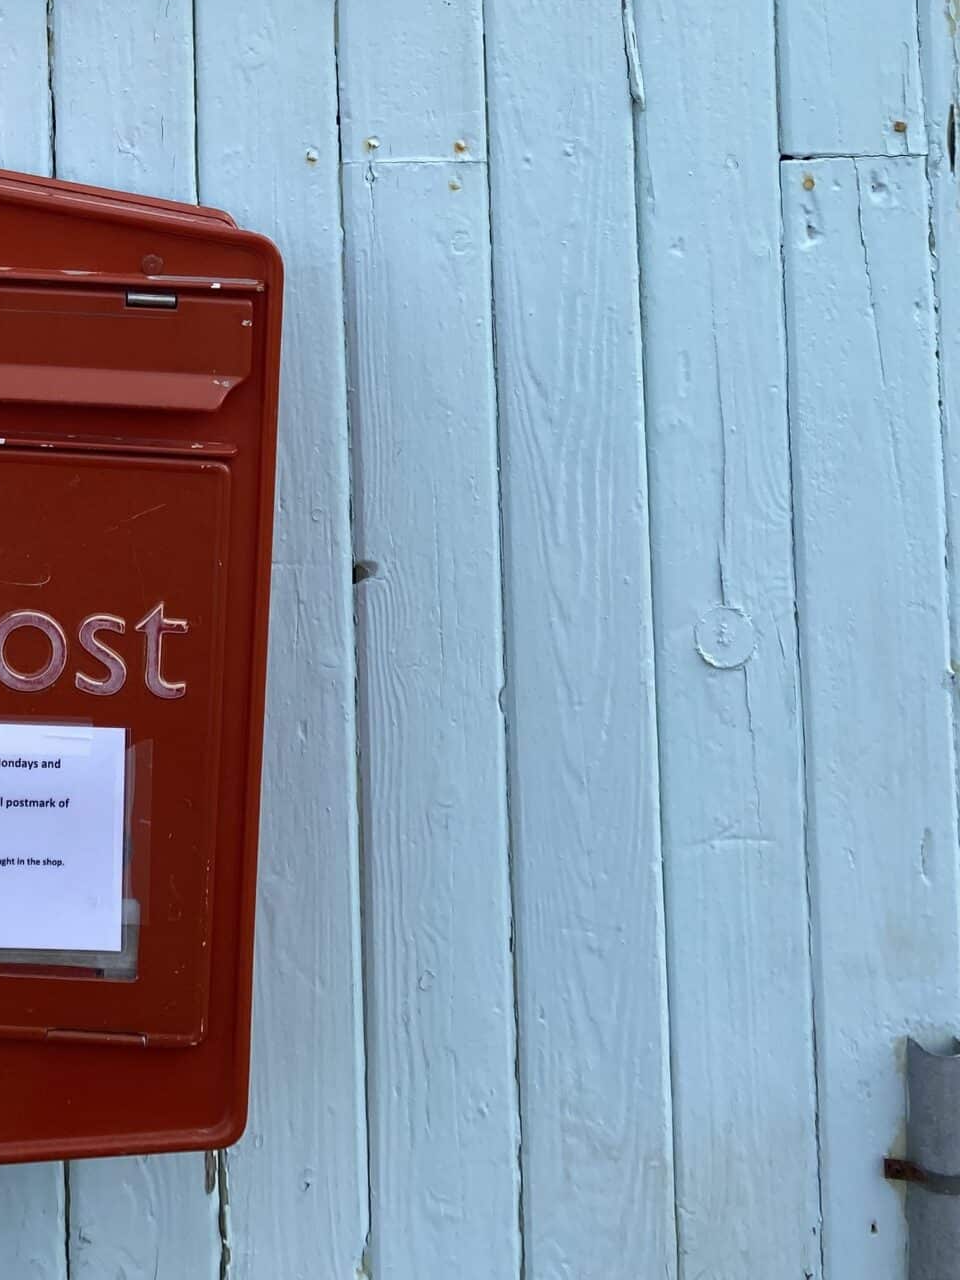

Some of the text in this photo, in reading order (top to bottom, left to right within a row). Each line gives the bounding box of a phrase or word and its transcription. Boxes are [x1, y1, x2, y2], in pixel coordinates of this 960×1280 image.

[41, 758, 61, 768] and
[6, 798, 56, 809] postmark
[58, 798, 70, 808] of
[17, 857, 25, 865] in
[27, 857, 40, 866] the
[42, 858, 64, 868] shop.
